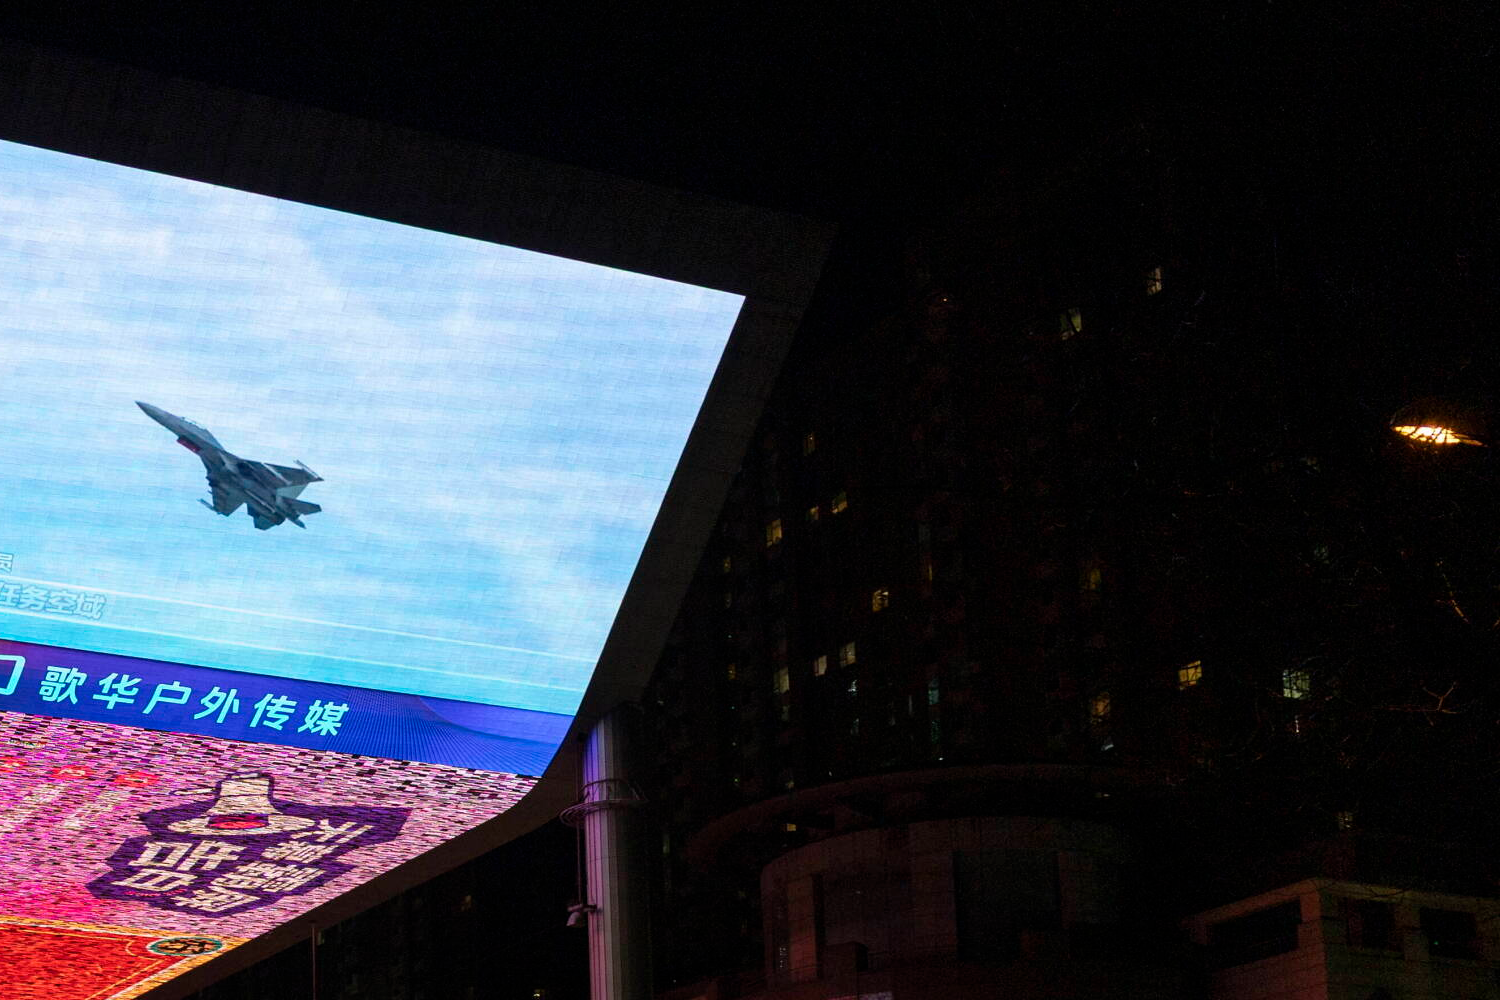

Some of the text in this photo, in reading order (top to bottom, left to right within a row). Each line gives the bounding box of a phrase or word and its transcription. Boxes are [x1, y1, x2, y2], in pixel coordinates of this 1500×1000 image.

[38, 665, 350, 737] 歌华户外传媒
